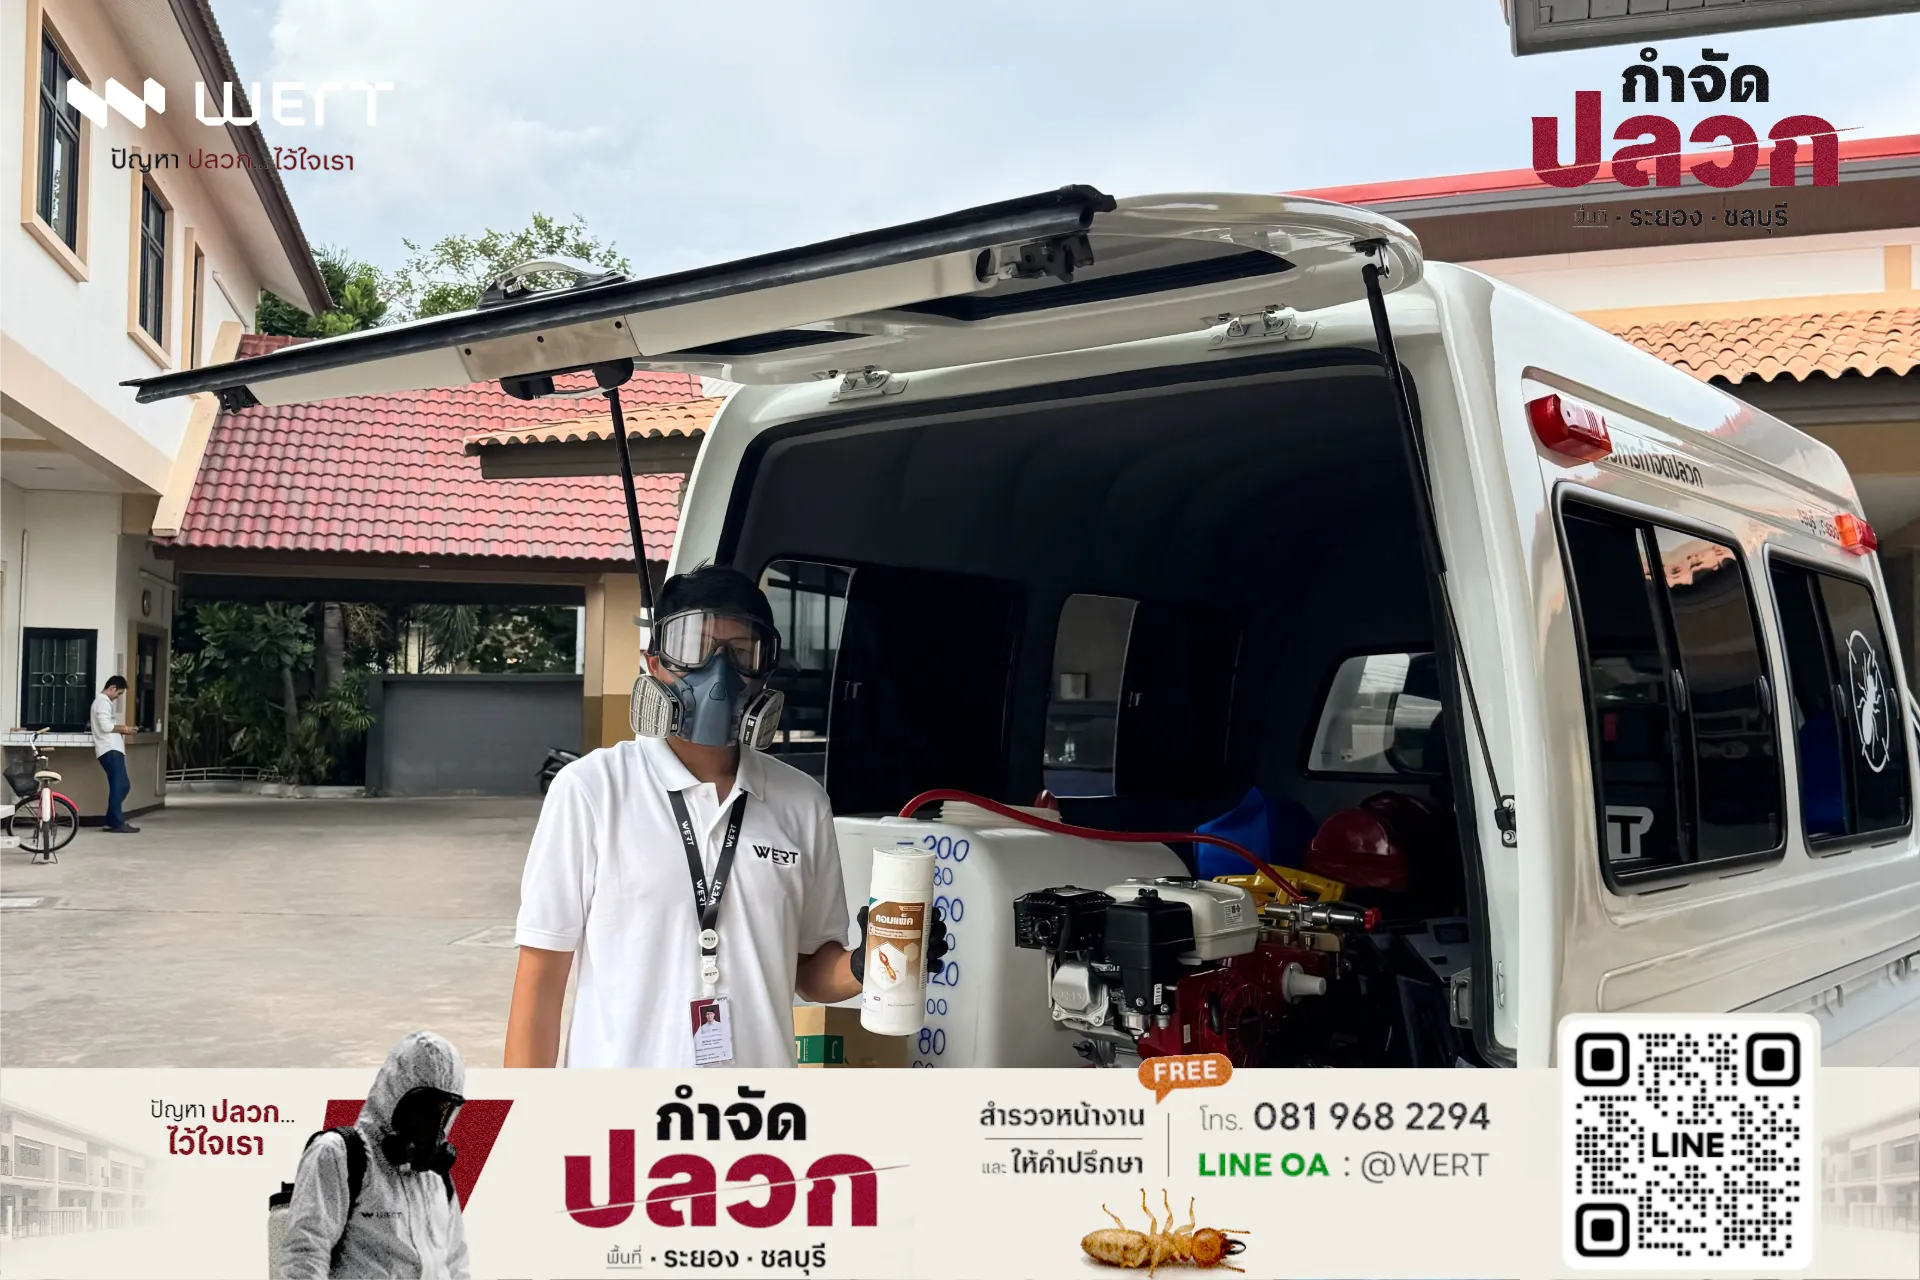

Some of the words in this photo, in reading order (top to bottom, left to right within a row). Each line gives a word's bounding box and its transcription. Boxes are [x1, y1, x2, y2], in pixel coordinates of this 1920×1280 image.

[681, 820, 695, 847] WERT
[724, 823, 737, 849] WERT
[752, 844, 799, 865] WERT
[923, 834, 970, 863] 200
[696, 878, 707, 907] WERT
[708, 879, 722, 907] WERT
[918, 1027, 946, 1056] 80
